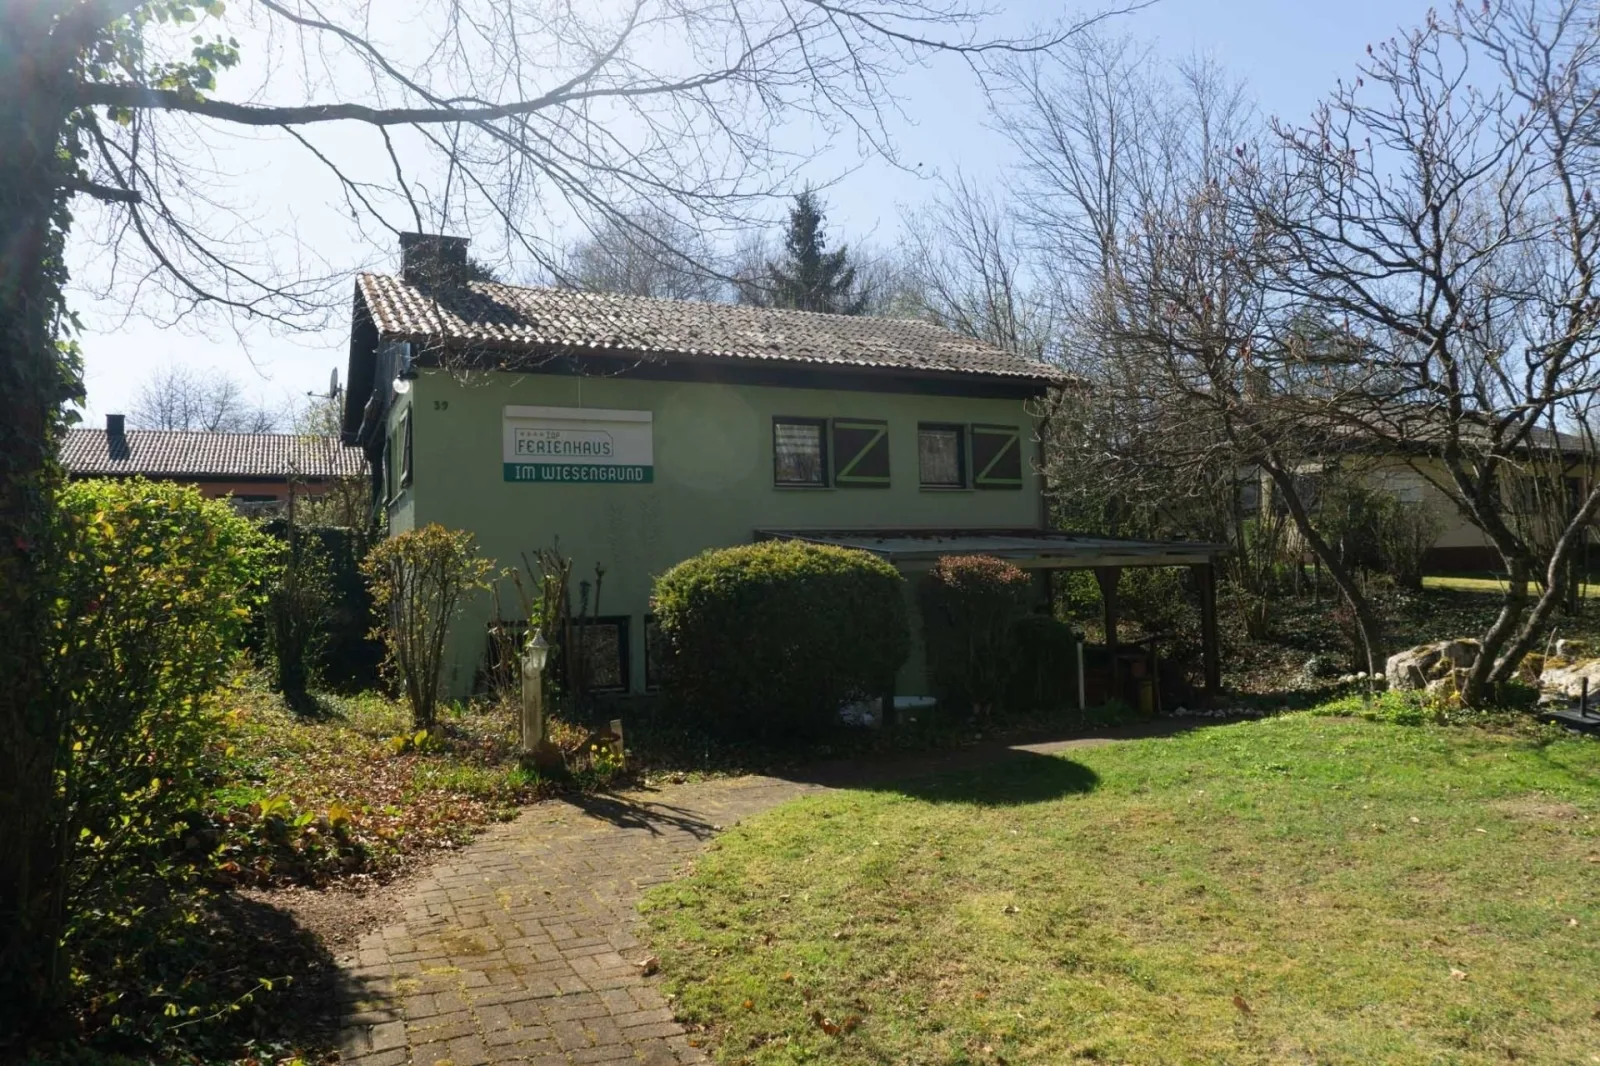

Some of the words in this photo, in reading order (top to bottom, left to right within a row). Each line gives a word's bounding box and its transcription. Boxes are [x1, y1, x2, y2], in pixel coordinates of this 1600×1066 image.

[433, 400, 449, 411] 39
[518, 439, 611, 455] FERIENHAUS
[515, 465, 536, 479] IM
[541, 466, 644, 481] WIESENGRUND
